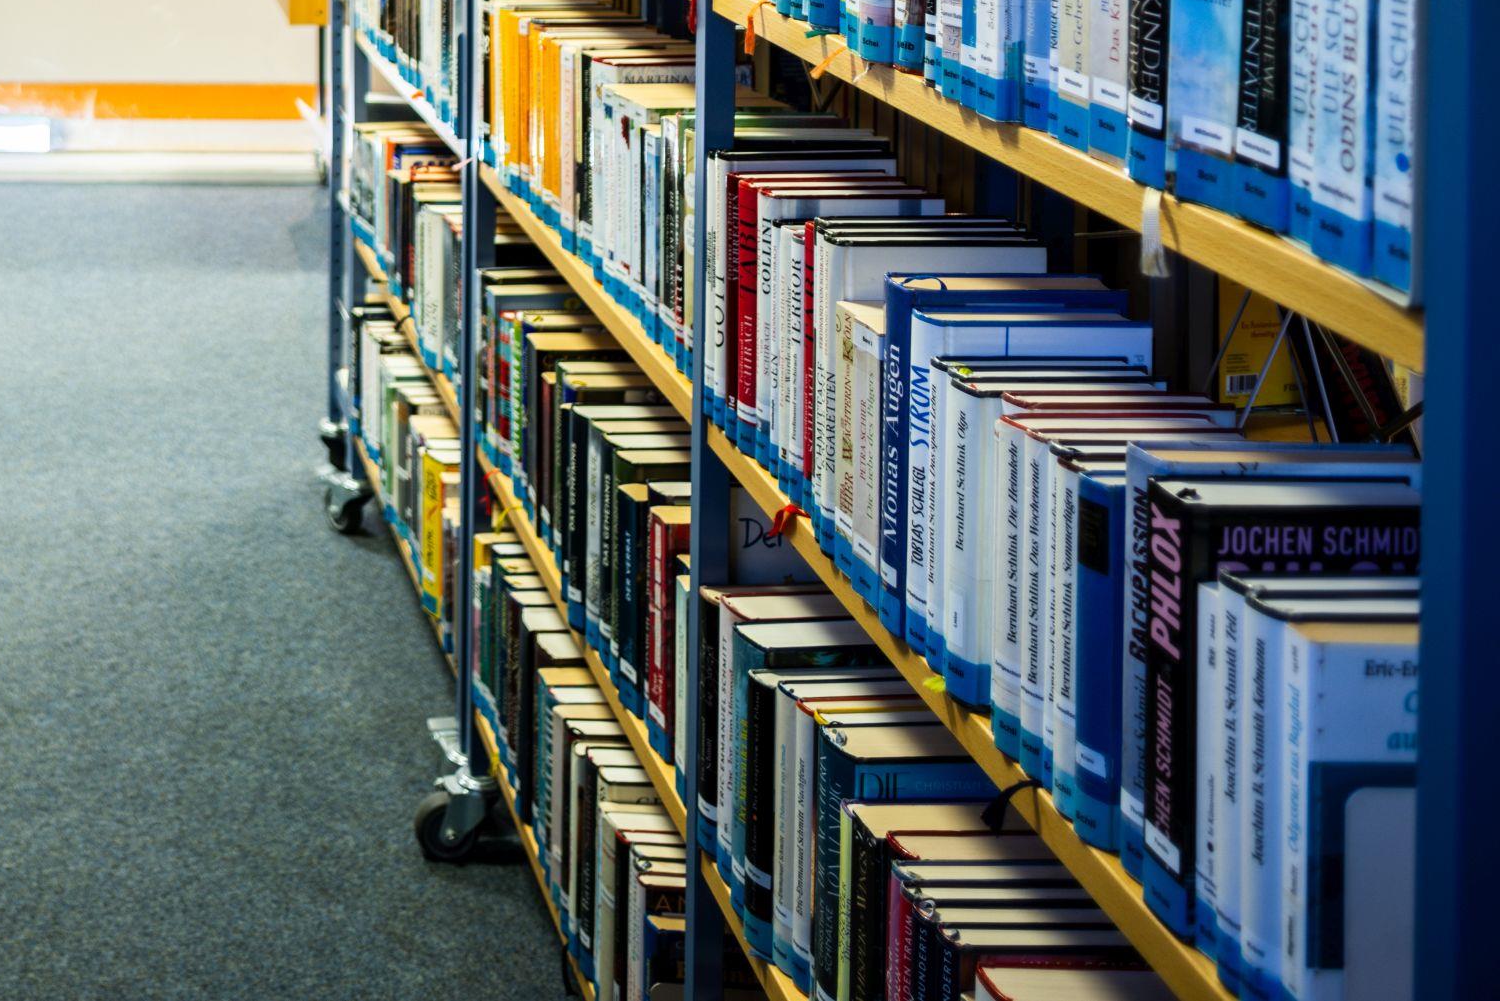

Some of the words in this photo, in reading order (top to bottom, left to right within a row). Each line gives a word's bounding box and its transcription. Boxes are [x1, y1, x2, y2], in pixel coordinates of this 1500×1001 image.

[1110, 29, 1120, 63] Das
[623, 73, 690, 84] MARTINA
[1292, 68, 1308, 116] ULF
[1323, 64, 1341, 114] ULF
[1340, 73, 1356, 173] ODINS
[1386, 93, 1407, 146] ULF
[739, 204, 757, 297] TABU
[761, 216, 772, 295] COLLINI
[742, 314, 753, 396] SCHIRACH
[883, 344, 903, 436] Augen
[909, 364, 930, 448] STROM
[826, 371, 836, 474] ZIGARETTEN
[956, 410, 967, 440] Olga
[866, 450, 875, 492] Liebe
[883, 446, 898, 545] Monas
[911, 465, 925, 517] SCHLEGL
[955, 444, 966, 487] Schlink
[1008, 440, 1019, 502] Heimkehr
[866, 495, 875, 519] Die
[955, 489, 965, 551] Bernhard
[1008, 502, 1018, 529] Die
[1029, 458, 1040, 537] Wochenende
[738, 517, 783, 548] Der
[911, 523, 925, 568] TOBIAS
[1007, 532, 1018, 579] Schlink
[1029, 540, 1039, 567] Das
[1063, 487, 1074, 577] Sommerlügen
[1217, 526, 1313, 555] JOCHEN
[1322, 526, 1420, 555] SCHMID
[1028, 570, 1039, 621] Schlink
[1061, 581, 1072, 634] Schlink
[1150, 501, 1181, 660] PHLOX
[1006, 584, 1018, 644] Bernhard
[1027, 622, 1039, 685] Bernhard
[1060, 636, 1071, 699] Bernhard
[1225, 646, 1237, 713] Schmidt
[1252, 637, 1265, 710] Kalmann
[719, 696, 728, 808] ERIC-EMMANUEL
[1155, 675, 1173, 778] SCHMIDT
[1224, 718, 1236, 732] B.
[1252, 712, 1265, 778] Schmidt
[796, 757, 806, 807] Nachtfeuer
[1223, 735, 1236, 803] Joachim
[796, 810, 805, 845] Schmitt
[1251, 800, 1264, 866] Joachim
[795, 846, 805, 917] Eric-Emmanuel
[903, 914, 913, 960] TRAUM
